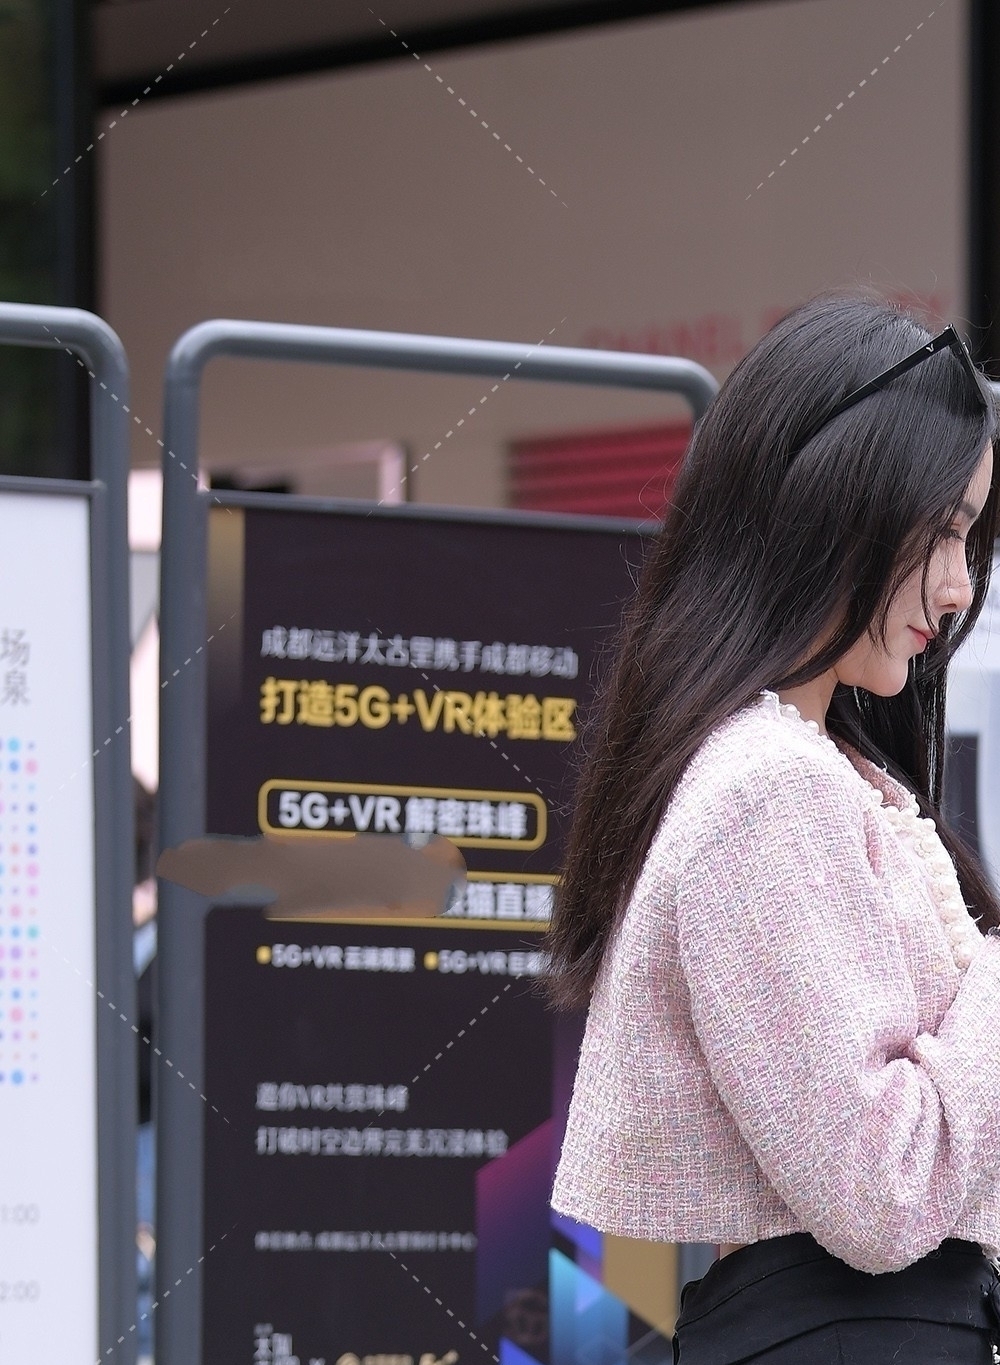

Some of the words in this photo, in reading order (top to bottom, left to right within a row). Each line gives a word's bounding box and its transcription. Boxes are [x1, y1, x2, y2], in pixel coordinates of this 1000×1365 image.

[260, 676, 578, 741] 打造5G+VR体验区
